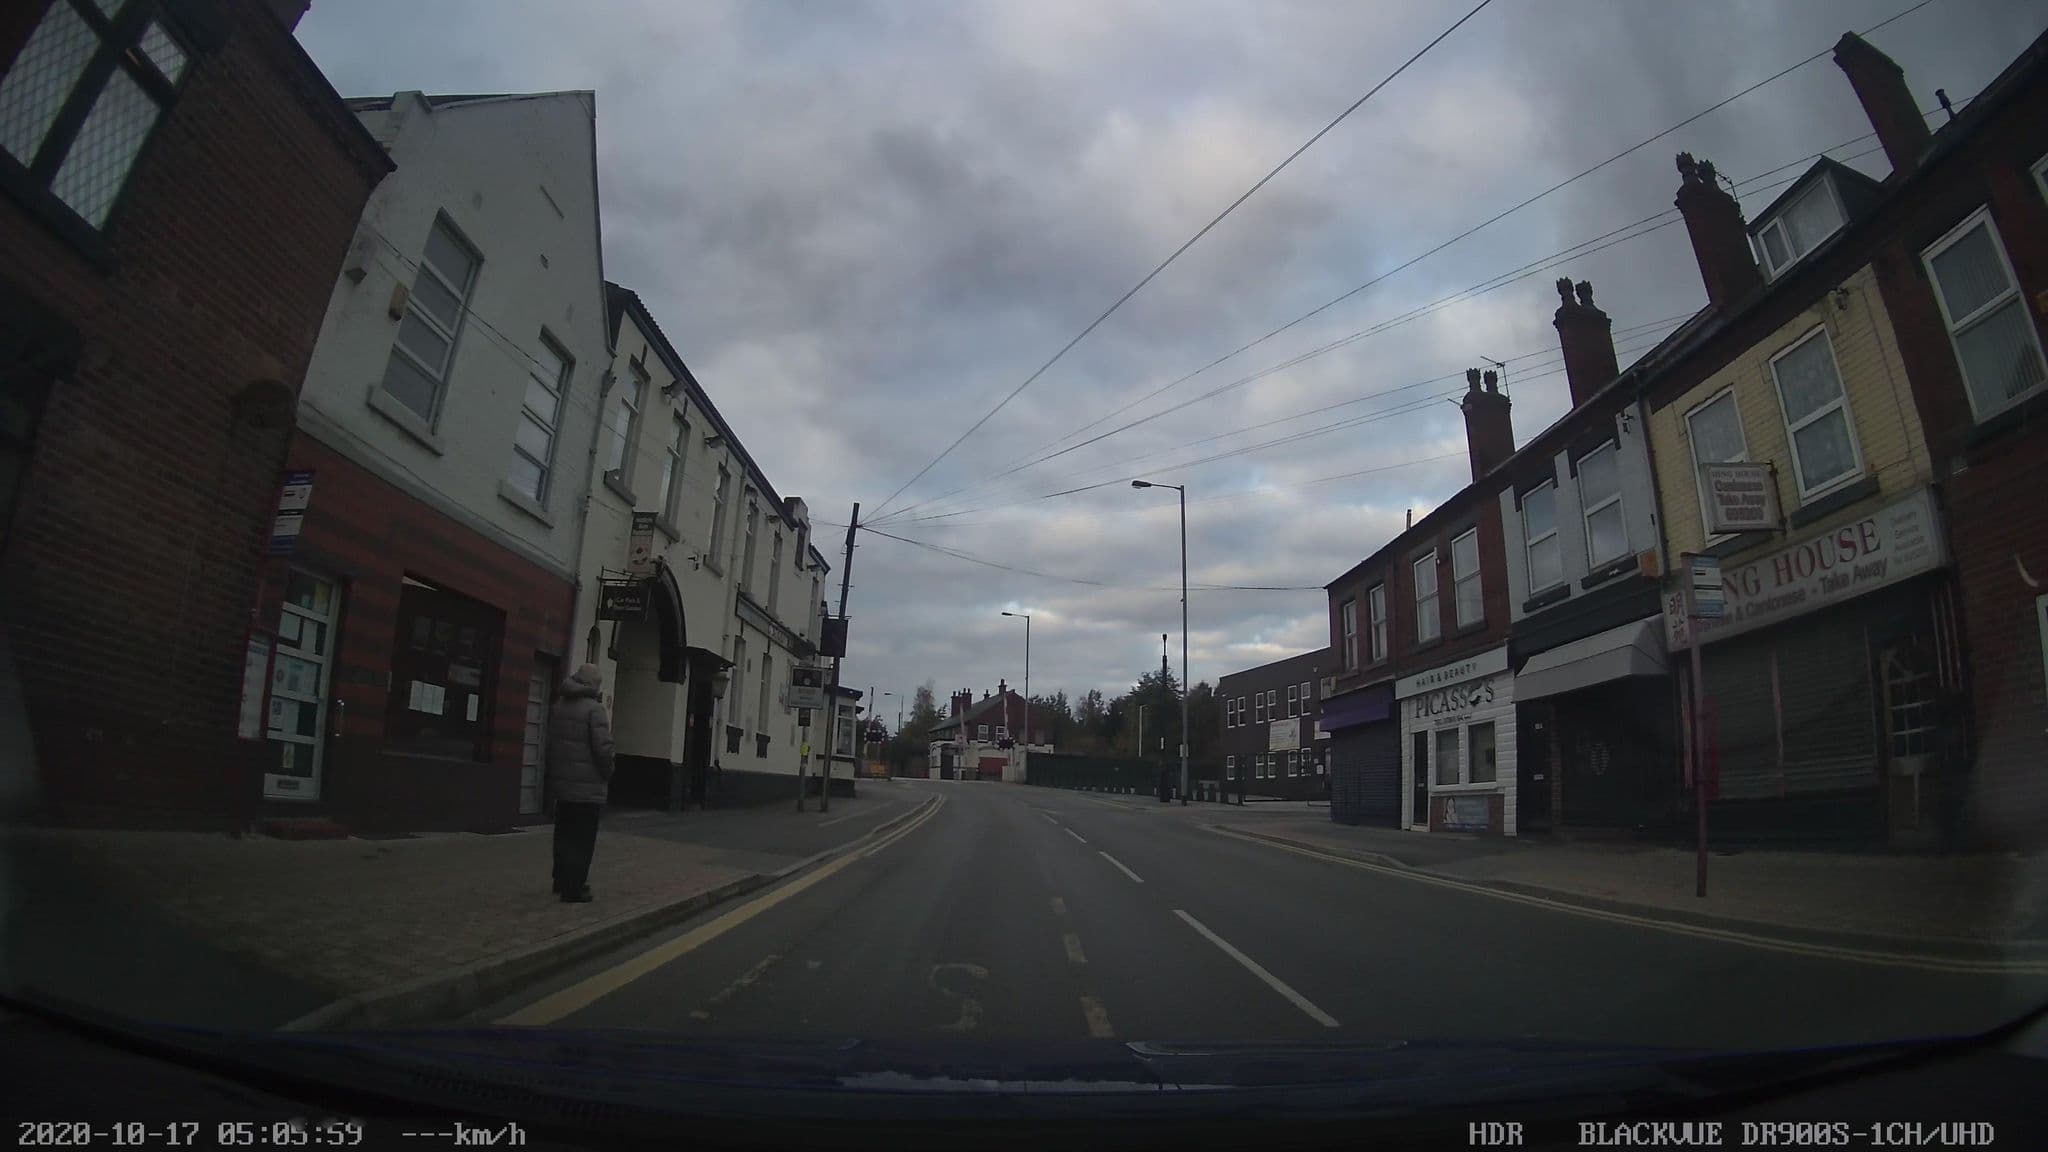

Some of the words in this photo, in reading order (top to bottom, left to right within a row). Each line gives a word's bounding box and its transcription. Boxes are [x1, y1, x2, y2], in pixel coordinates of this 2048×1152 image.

[1773, 519, 1881, 588] HOUSE
[1819, 573, 1850, 595] Take
[1853, 557, 1888, 584] Away
[1416, 675, 1434, 688] HAIR
[1444, 662, 1478, 681] BEAUTY
